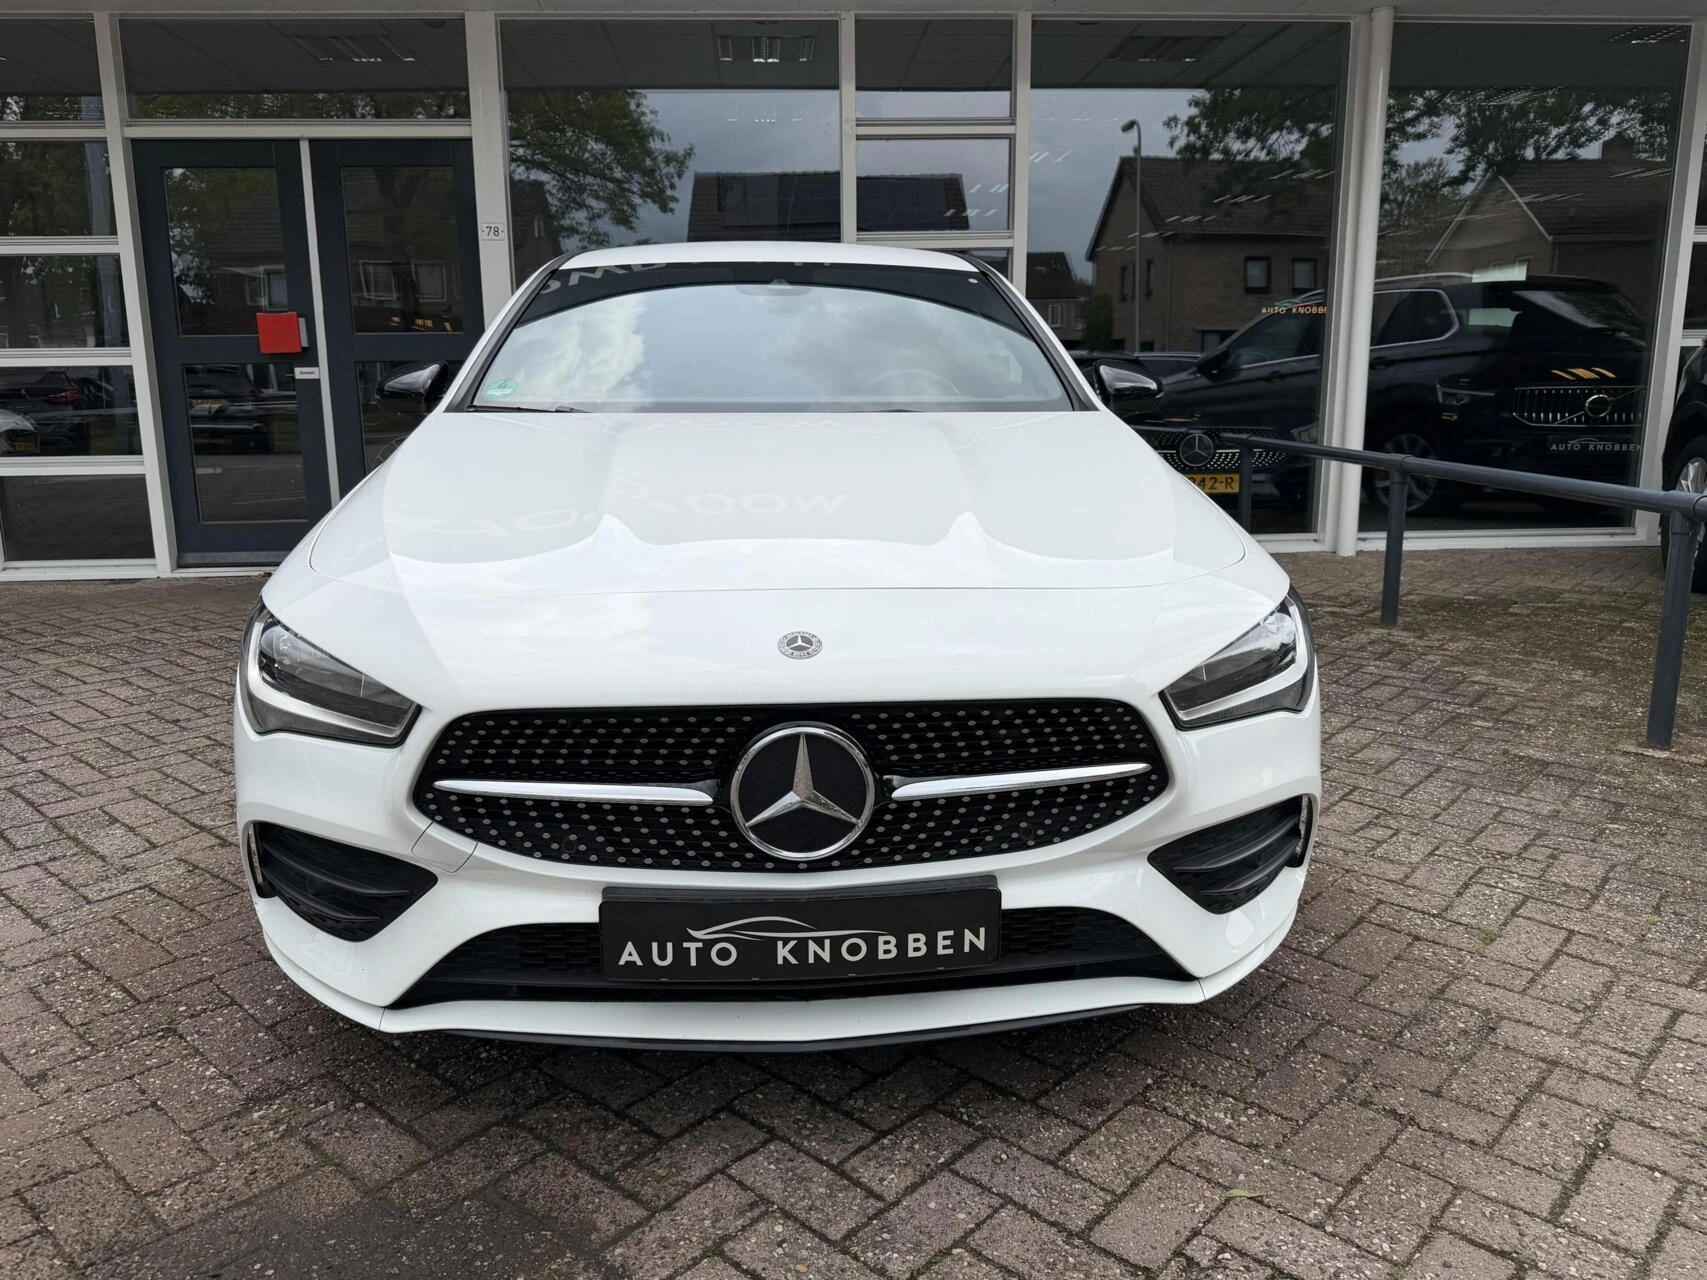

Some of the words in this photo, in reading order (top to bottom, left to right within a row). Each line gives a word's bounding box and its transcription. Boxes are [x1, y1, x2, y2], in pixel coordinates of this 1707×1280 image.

[486, 226, 500, 236] 78
[1261, 306, 1287, 315] AUTO
[1549, 443, 1582, 452] AUTO
[618, 941, 737, 967] AUTO
[777, 927, 987, 965] KNOBBEN
